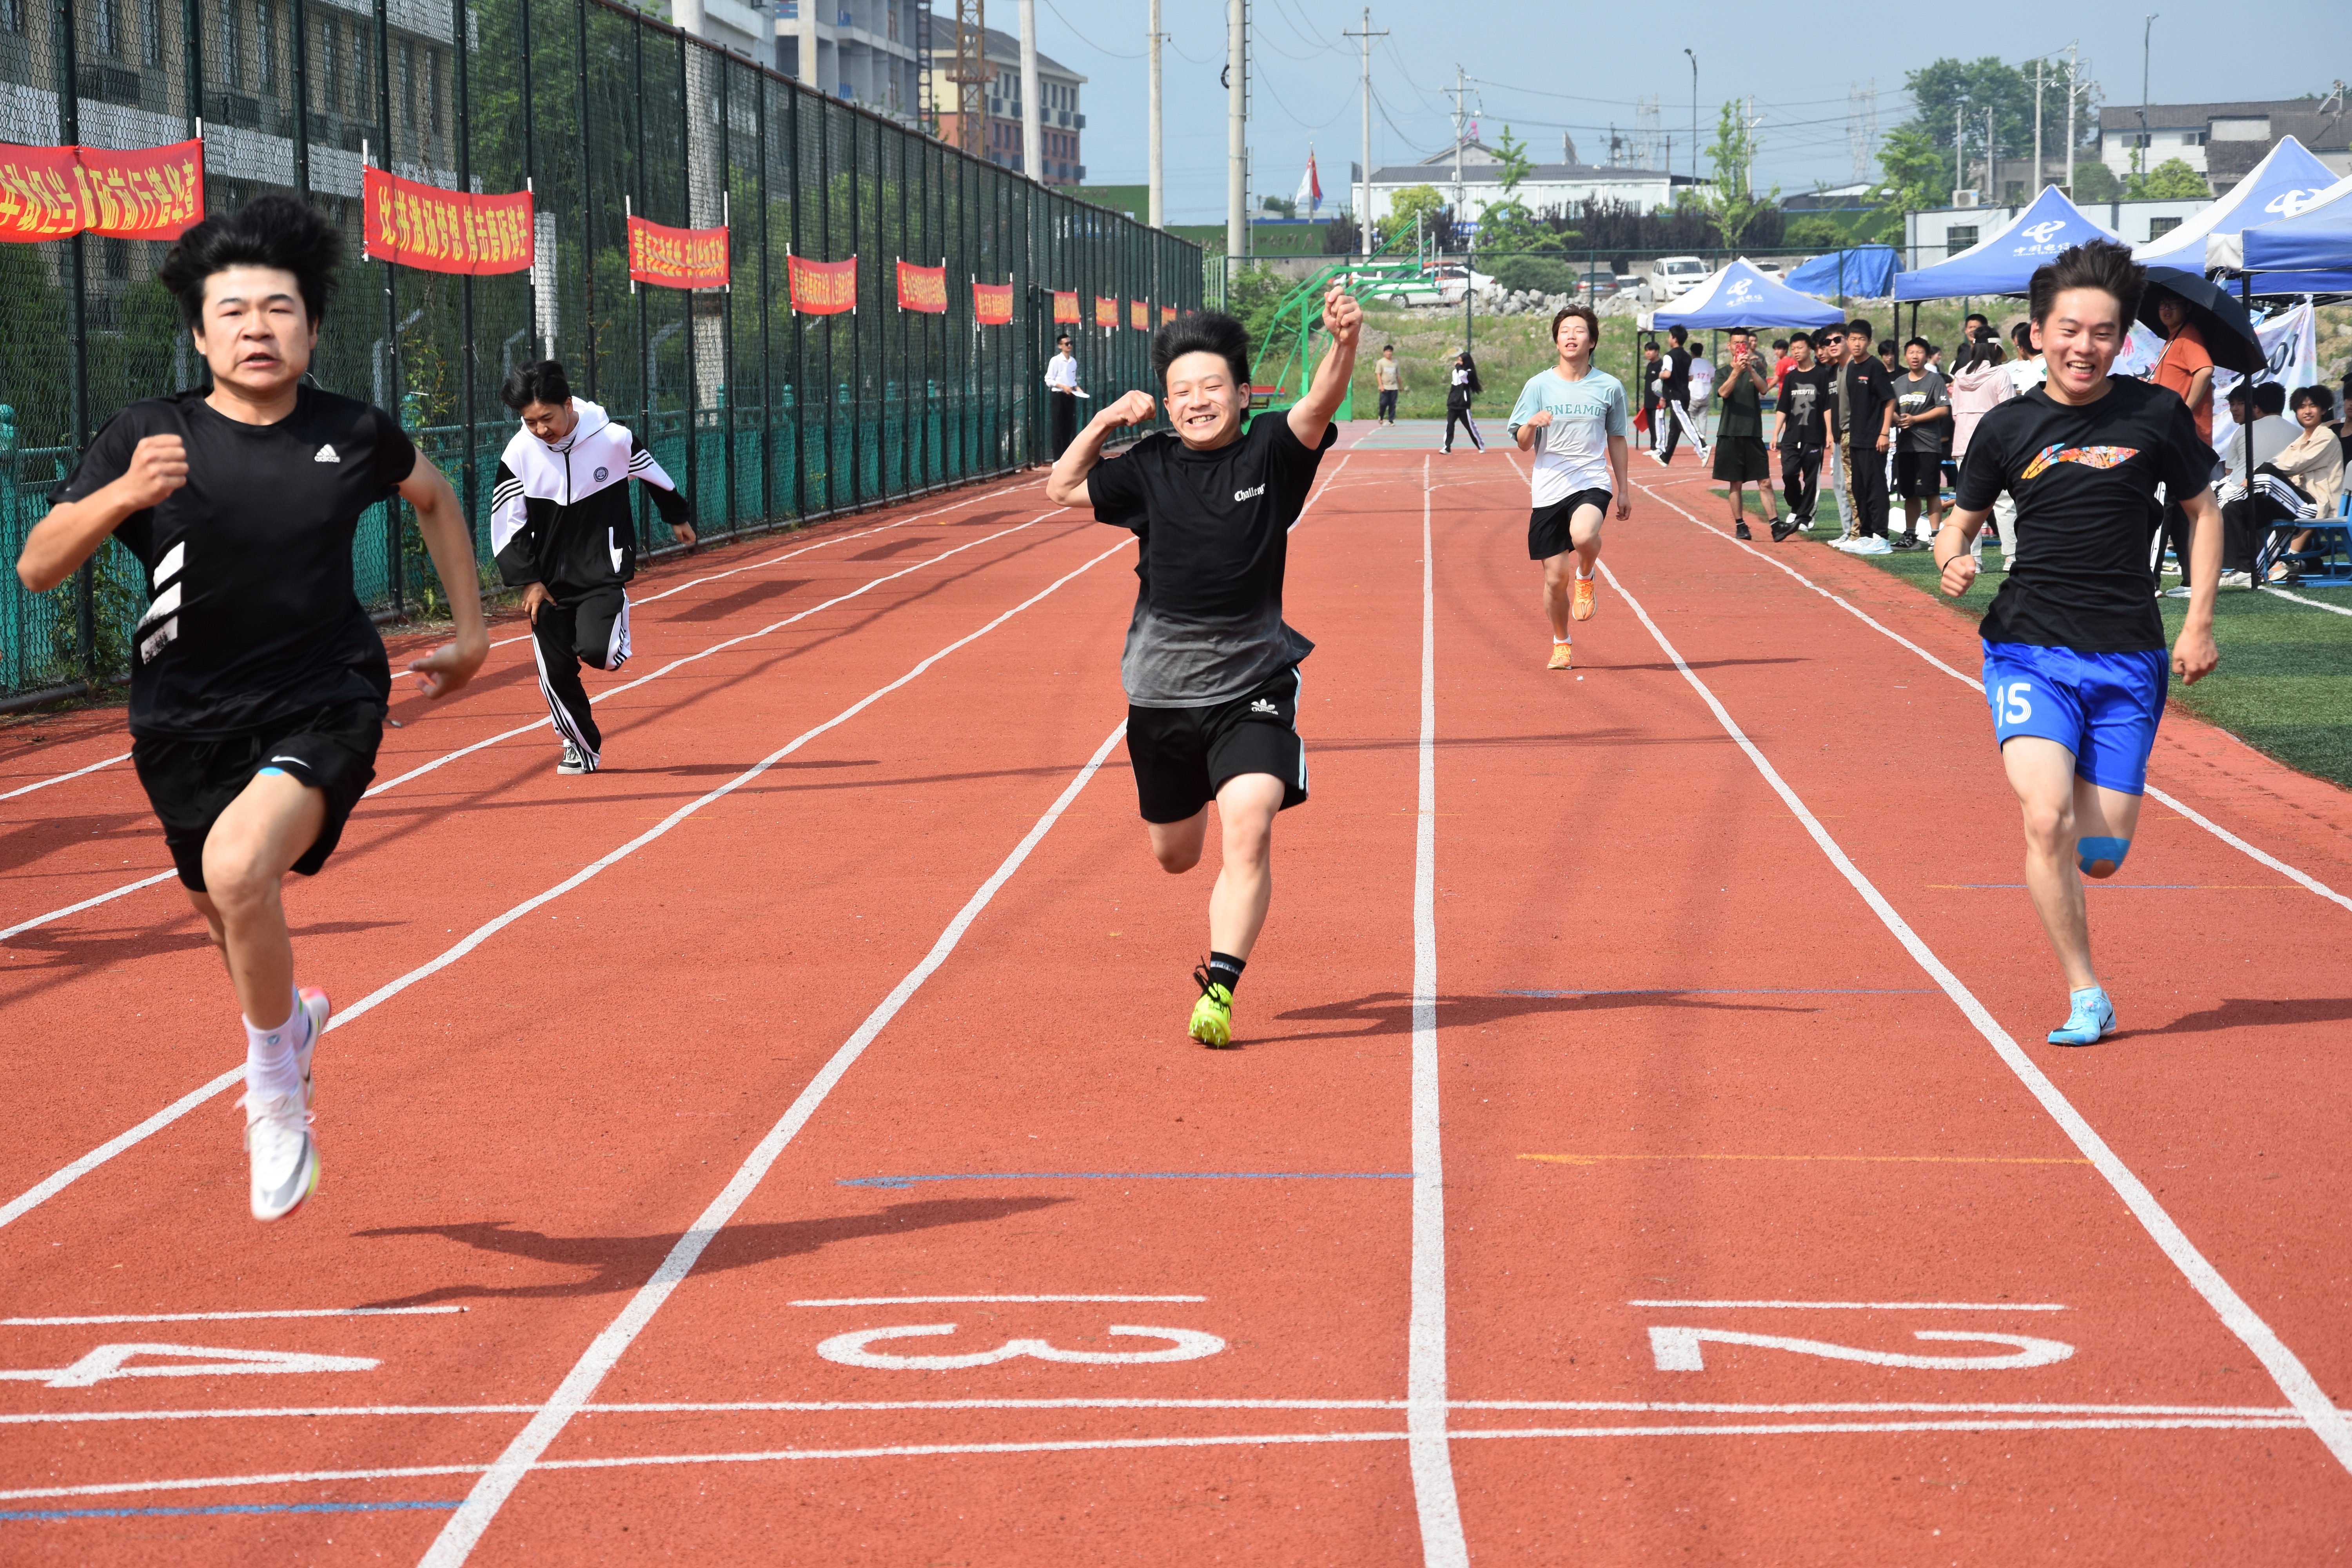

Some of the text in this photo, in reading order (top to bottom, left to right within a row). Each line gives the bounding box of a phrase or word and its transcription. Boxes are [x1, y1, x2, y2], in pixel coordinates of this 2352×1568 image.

[378, 185, 527, 263] 比拼激扬梦想 搏击磨砺锋芒
[1996, 682, 2032, 728] 15
[0, 1343, 383, 1388] 4
[816, 1323, 1226, 1370] 3
[1648, 1326, 2076, 1371] 2
